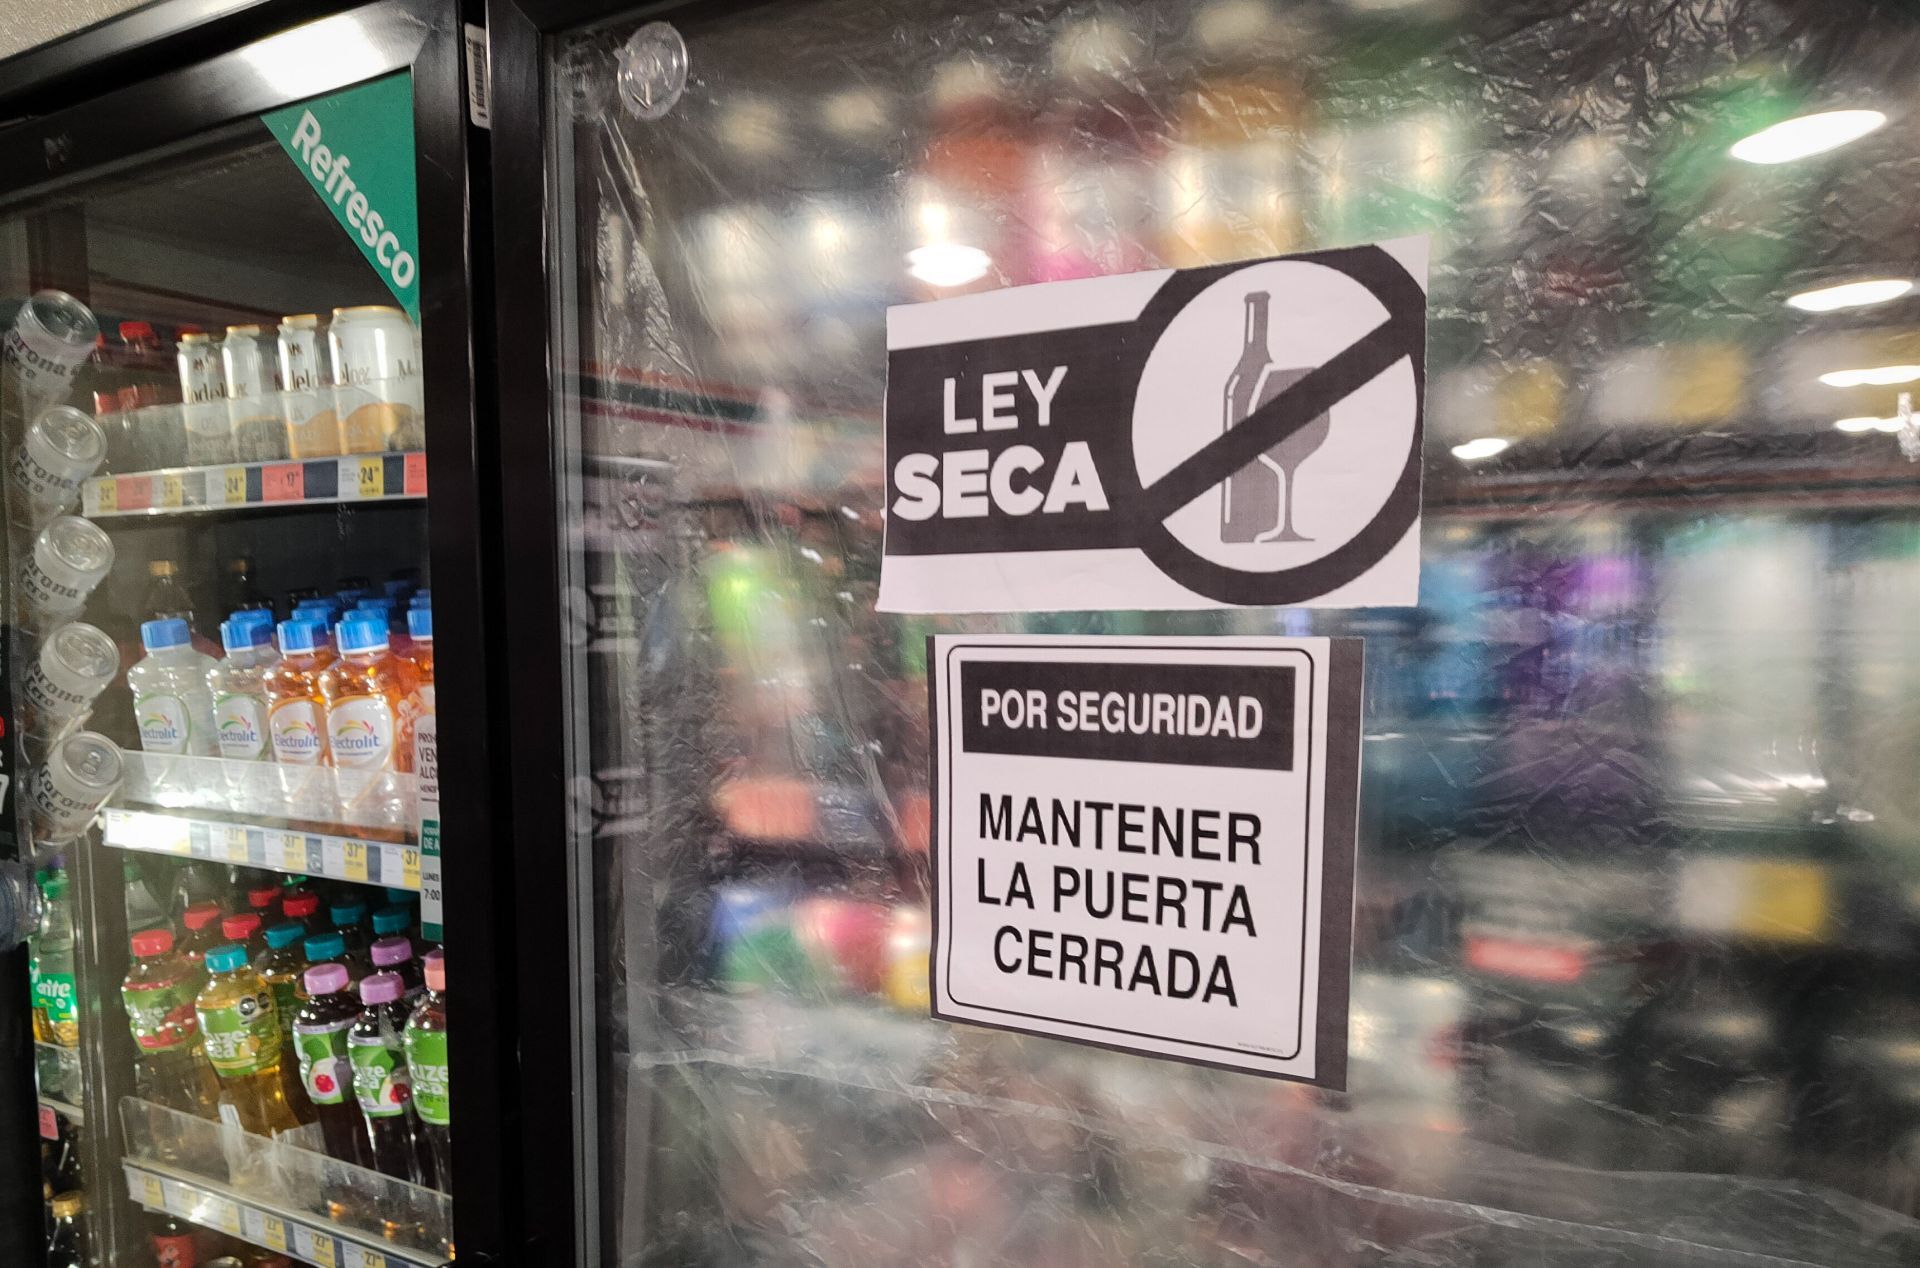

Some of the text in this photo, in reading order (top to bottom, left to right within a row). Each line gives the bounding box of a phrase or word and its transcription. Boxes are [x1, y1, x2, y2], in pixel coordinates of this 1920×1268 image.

[291, 109, 415, 289] Refresco
[943, 365, 1069, 436] LEY
[892, 440, 1110, 522] SECA
[981, 688, 1264, 740] POR SEGURIDAD
[979, 792, 1262, 866] MANTENER
[977, 857, 1258, 938] LA PUERTA
[993, 925, 1239, 1008] CERRADA
